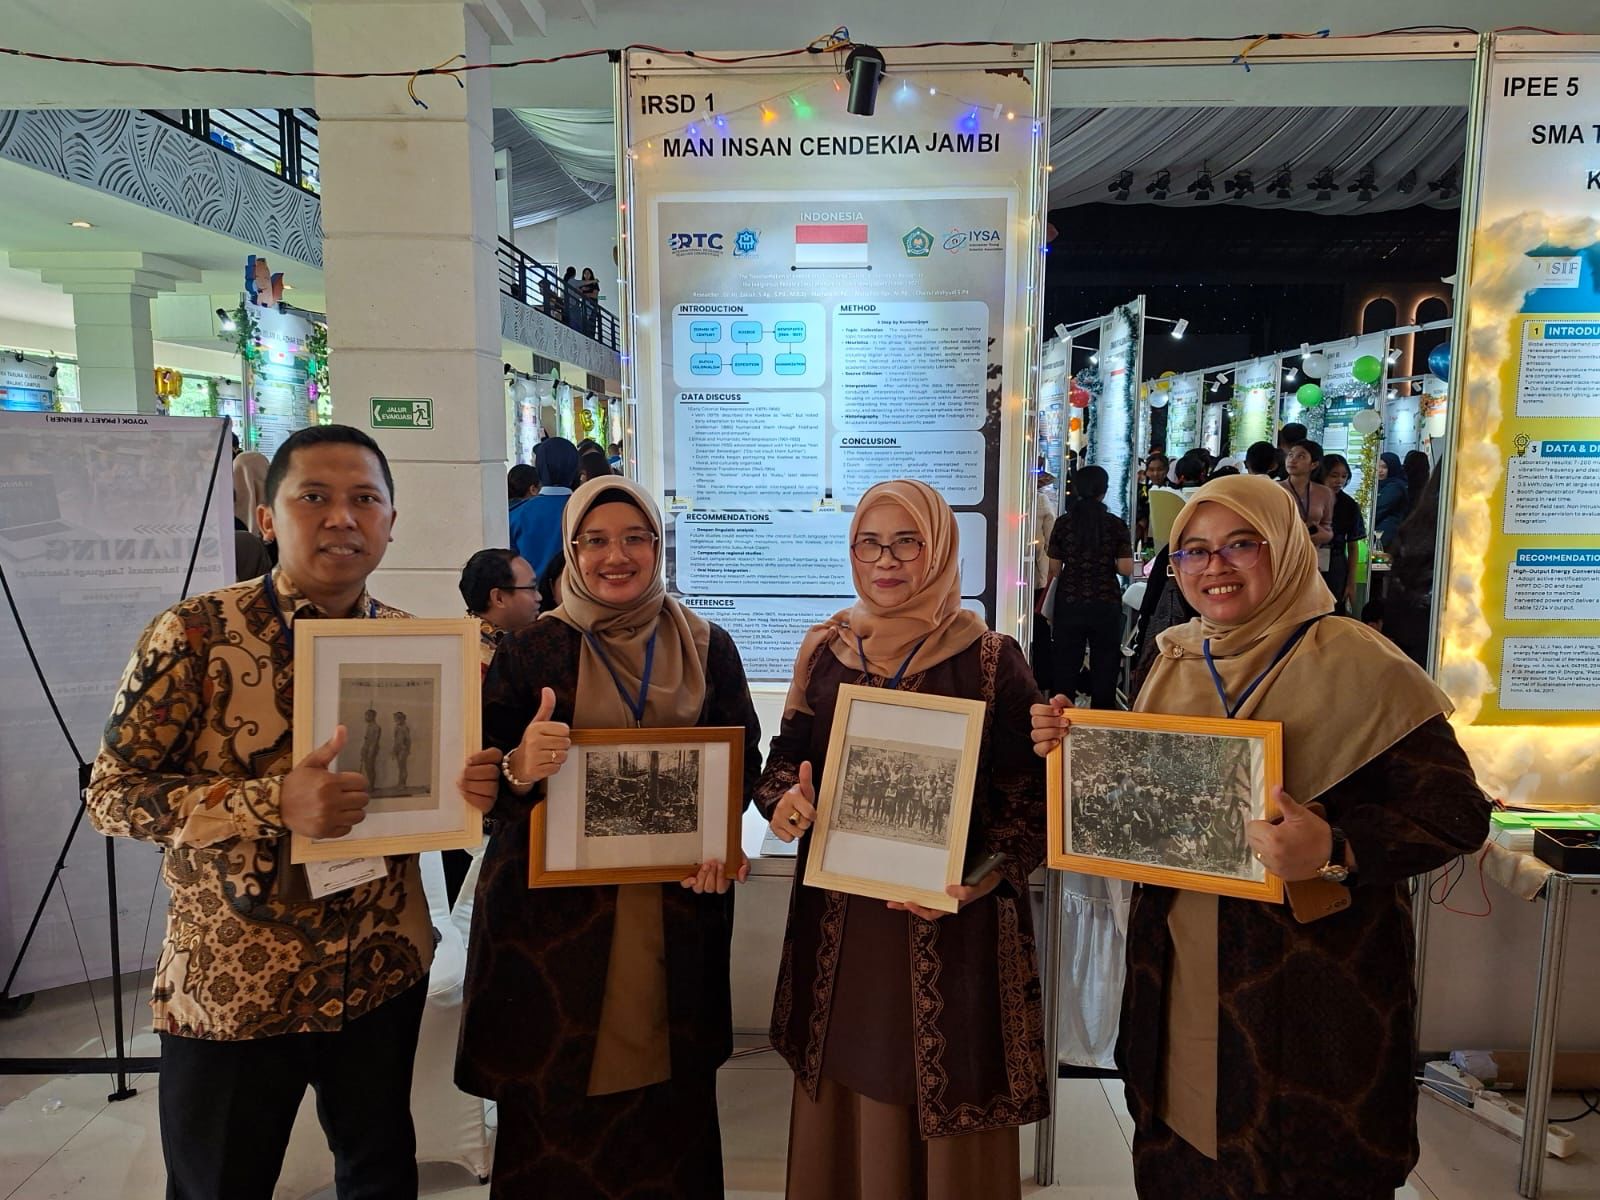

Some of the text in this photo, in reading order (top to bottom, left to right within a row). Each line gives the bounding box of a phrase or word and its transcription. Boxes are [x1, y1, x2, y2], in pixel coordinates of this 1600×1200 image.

[1503, 77, 1579, 97] IPEE 5
[640, 93, 715, 115] IRSD 1
[1532, 125, 1584, 144] SMA
[663, 132, 1000, 158] MAN INSAN CENDEKIA JAMBI
[799, 211, 864, 221] INDONESIA
[969, 230, 1000, 241] IYSA
[679, 305, 744, 313] INTRODUCTION
[840, 304, 877, 312] METHOD
[1548, 327, 1600, 336] INTRODU
[686, 513, 770, 521] RECOMMENDATIONS
[685, 599, 734, 607] REFERENCES
